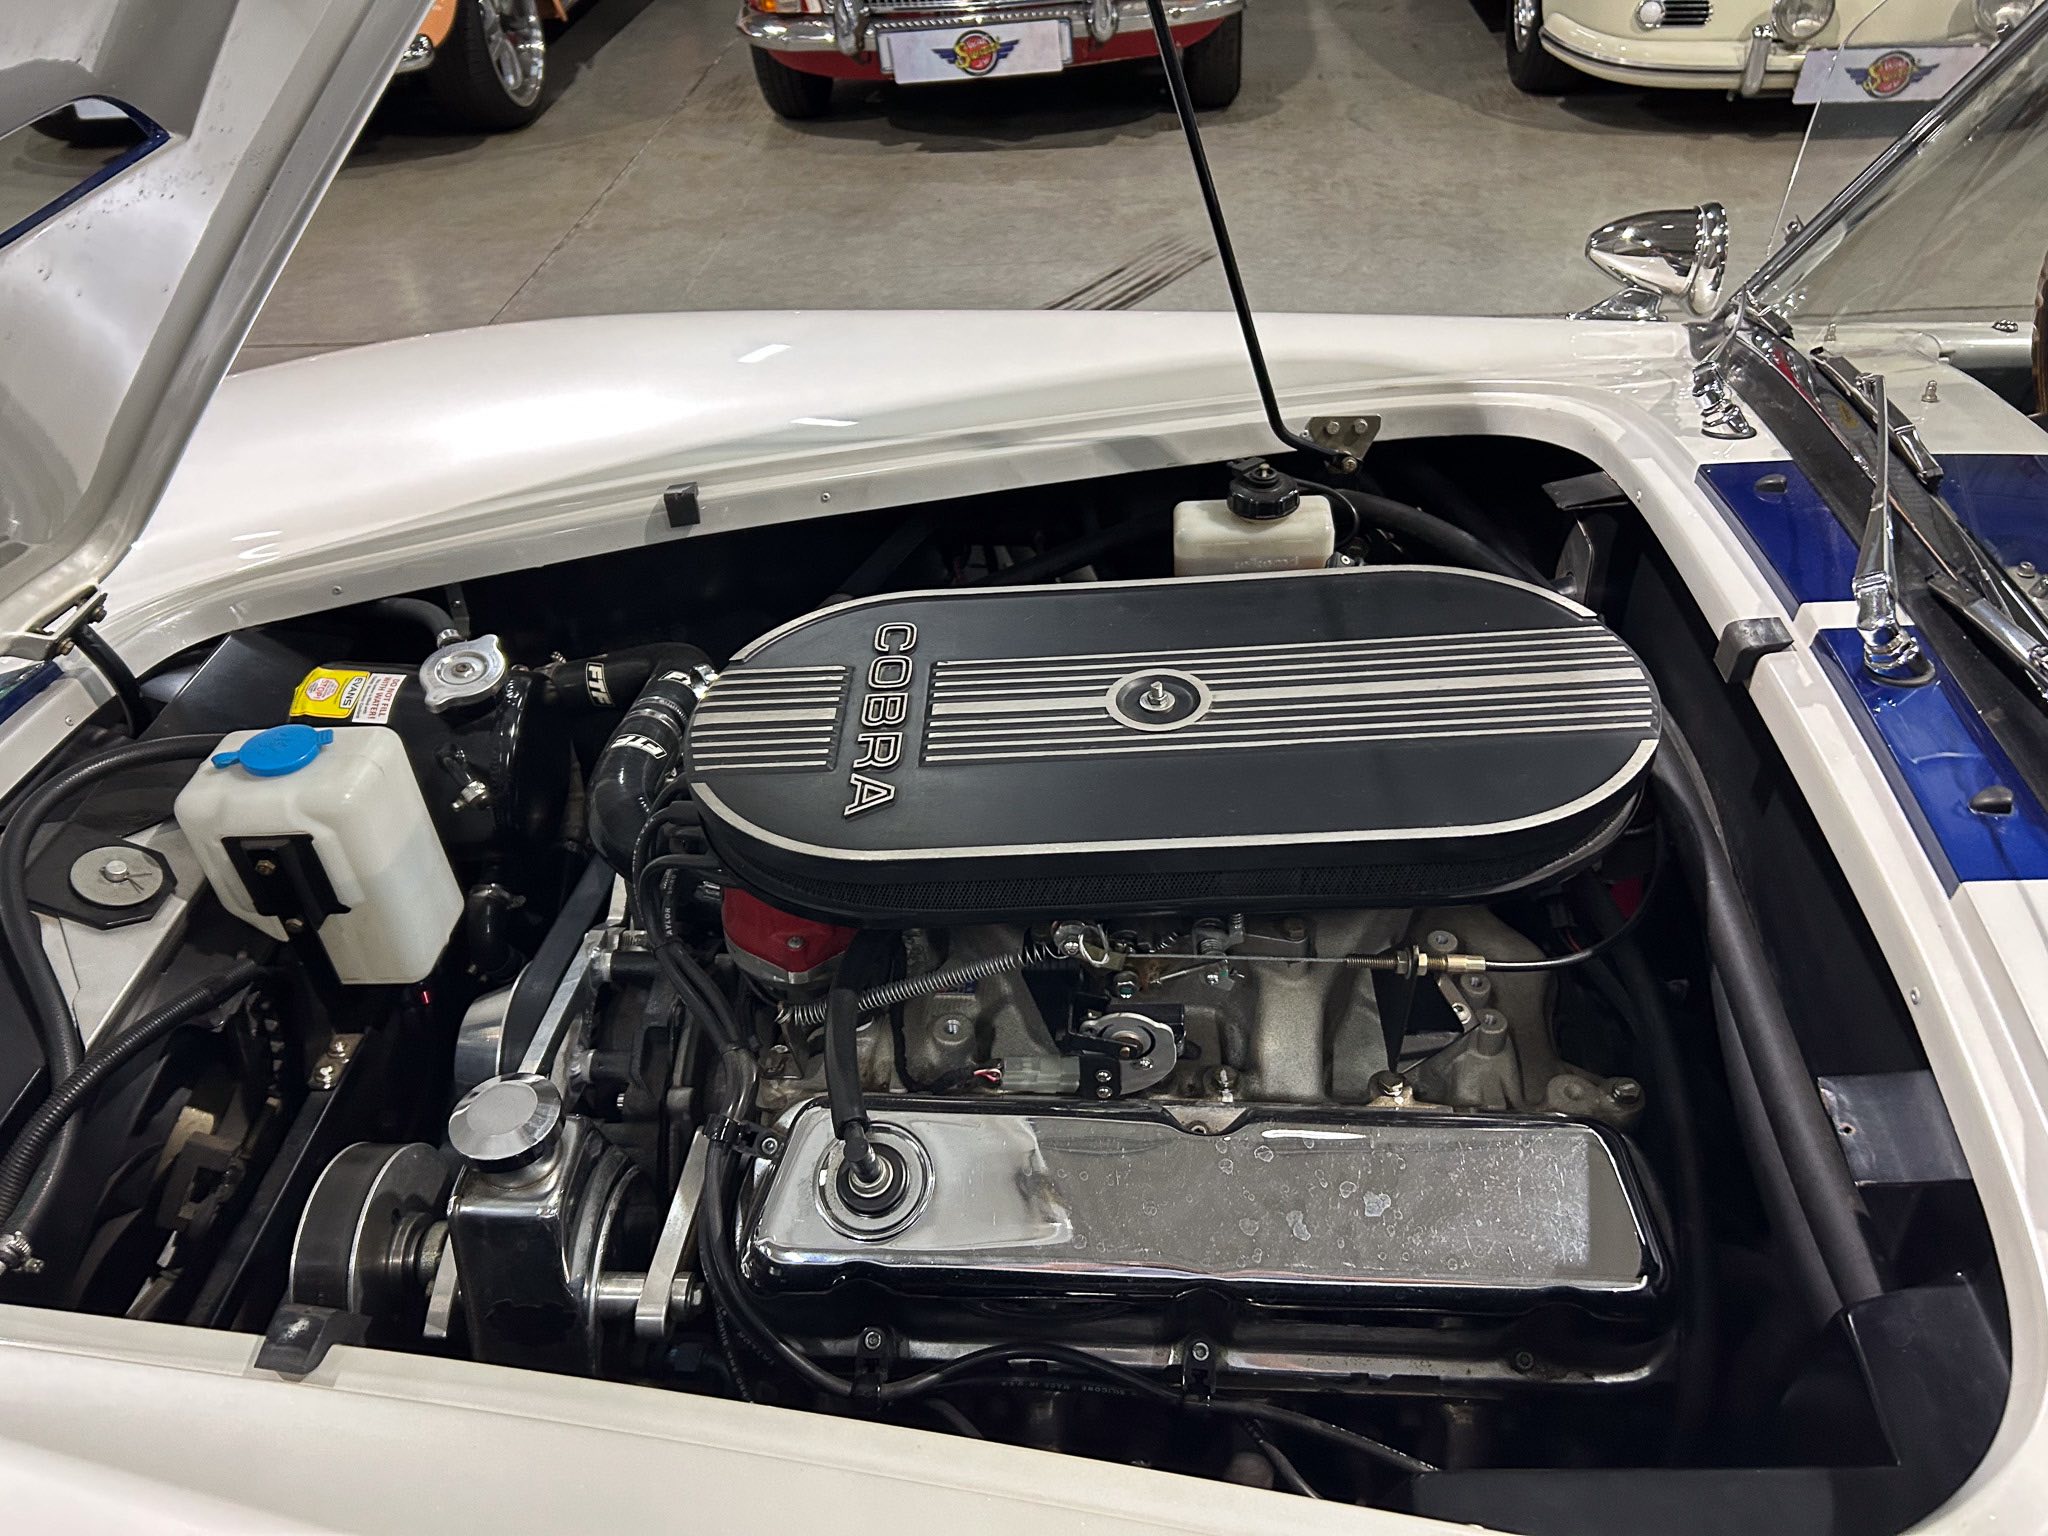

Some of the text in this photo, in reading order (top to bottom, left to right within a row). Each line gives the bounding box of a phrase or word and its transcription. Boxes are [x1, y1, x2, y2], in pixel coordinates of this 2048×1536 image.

[342, 676, 364, 706] EVANS
[377, 677, 400, 717] DO NOT FILL
[588, 664, 612, 705] FTF
[366, 691, 383, 719] WATER!
[844, 621, 918, 817] COBRA
[611, 735, 666, 759] FTF
[663, 907, 673, 937] AYLOR
